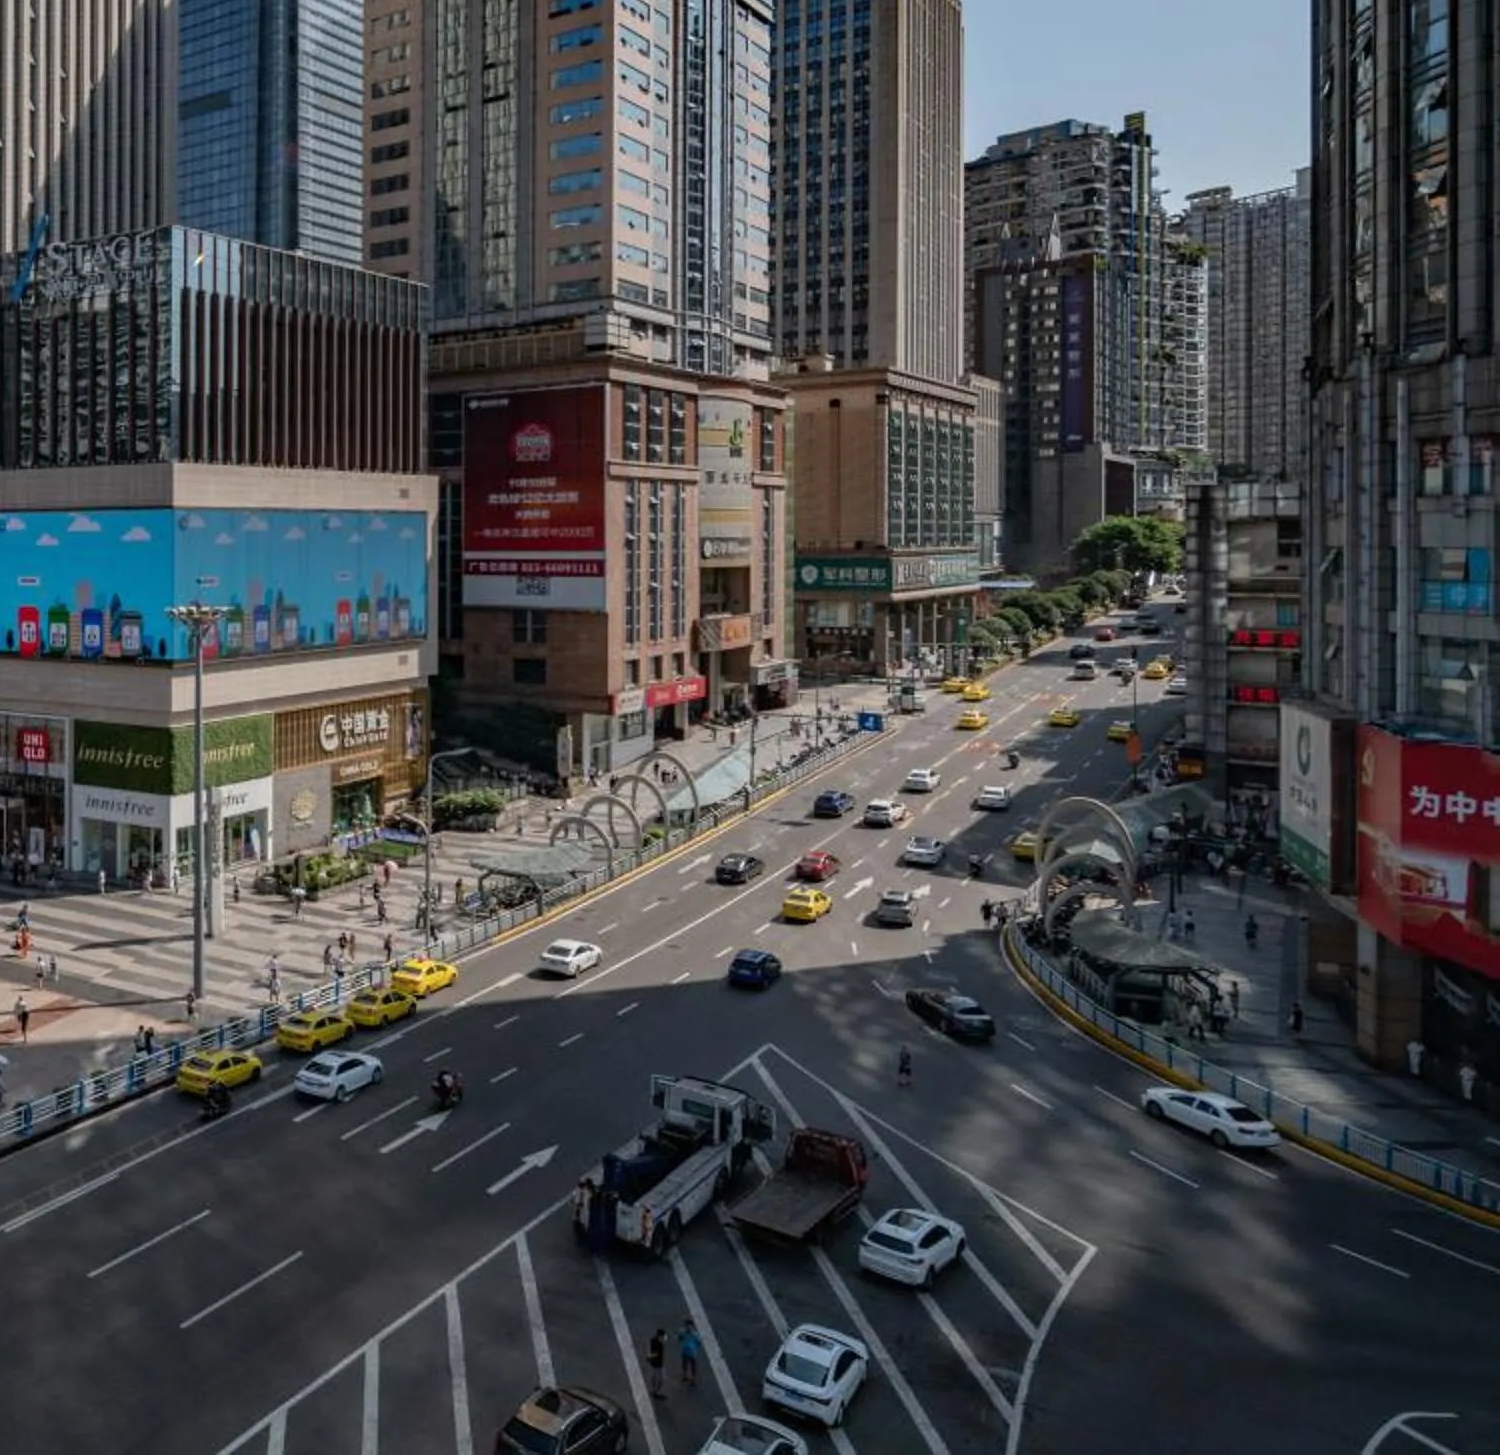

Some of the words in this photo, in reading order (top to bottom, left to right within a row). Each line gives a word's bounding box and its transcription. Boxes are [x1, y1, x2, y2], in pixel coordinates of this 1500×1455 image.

[47, 231, 155, 276] STAGE
[341, 707, 388, 740] 中国黄金
[23, 733, 43, 745] UNI
[23, 747, 45, 759] QLO
[77, 742, 165, 769] innisfree
[203, 741, 255, 764] nnisfree
[85, 795, 155, 817] innisfree
